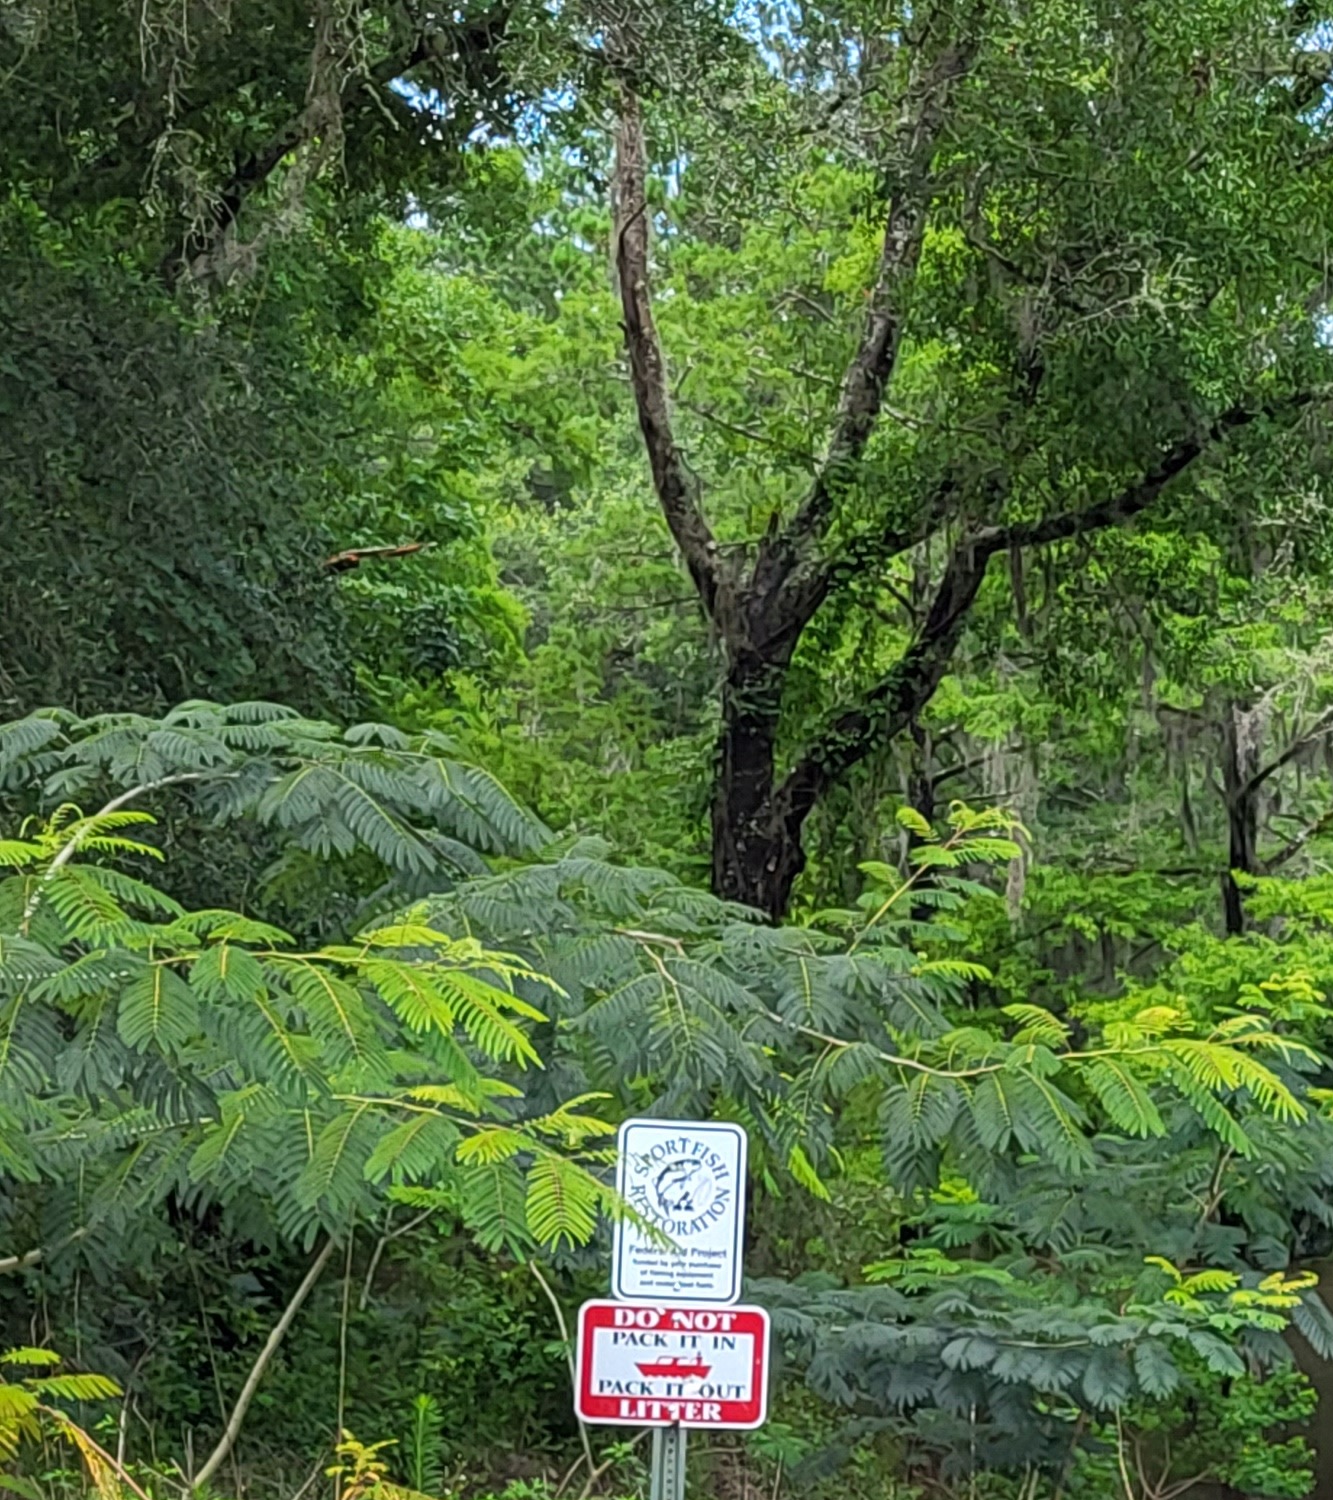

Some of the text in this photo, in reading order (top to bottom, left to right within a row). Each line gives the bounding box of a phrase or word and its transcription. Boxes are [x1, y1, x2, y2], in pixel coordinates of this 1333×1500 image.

[628, 1185, 731, 1236] RESTORATION
[629, 1244, 667, 1255] Federa
[691, 1247, 727, 1259] Project
[614, 1309, 737, 1331] DO NOT
[612, 1332, 736, 1350] PACK IT IN
[599, 1380, 746, 1399] PACK IT OUT
[619, 1400, 722, 1421] LITTER
